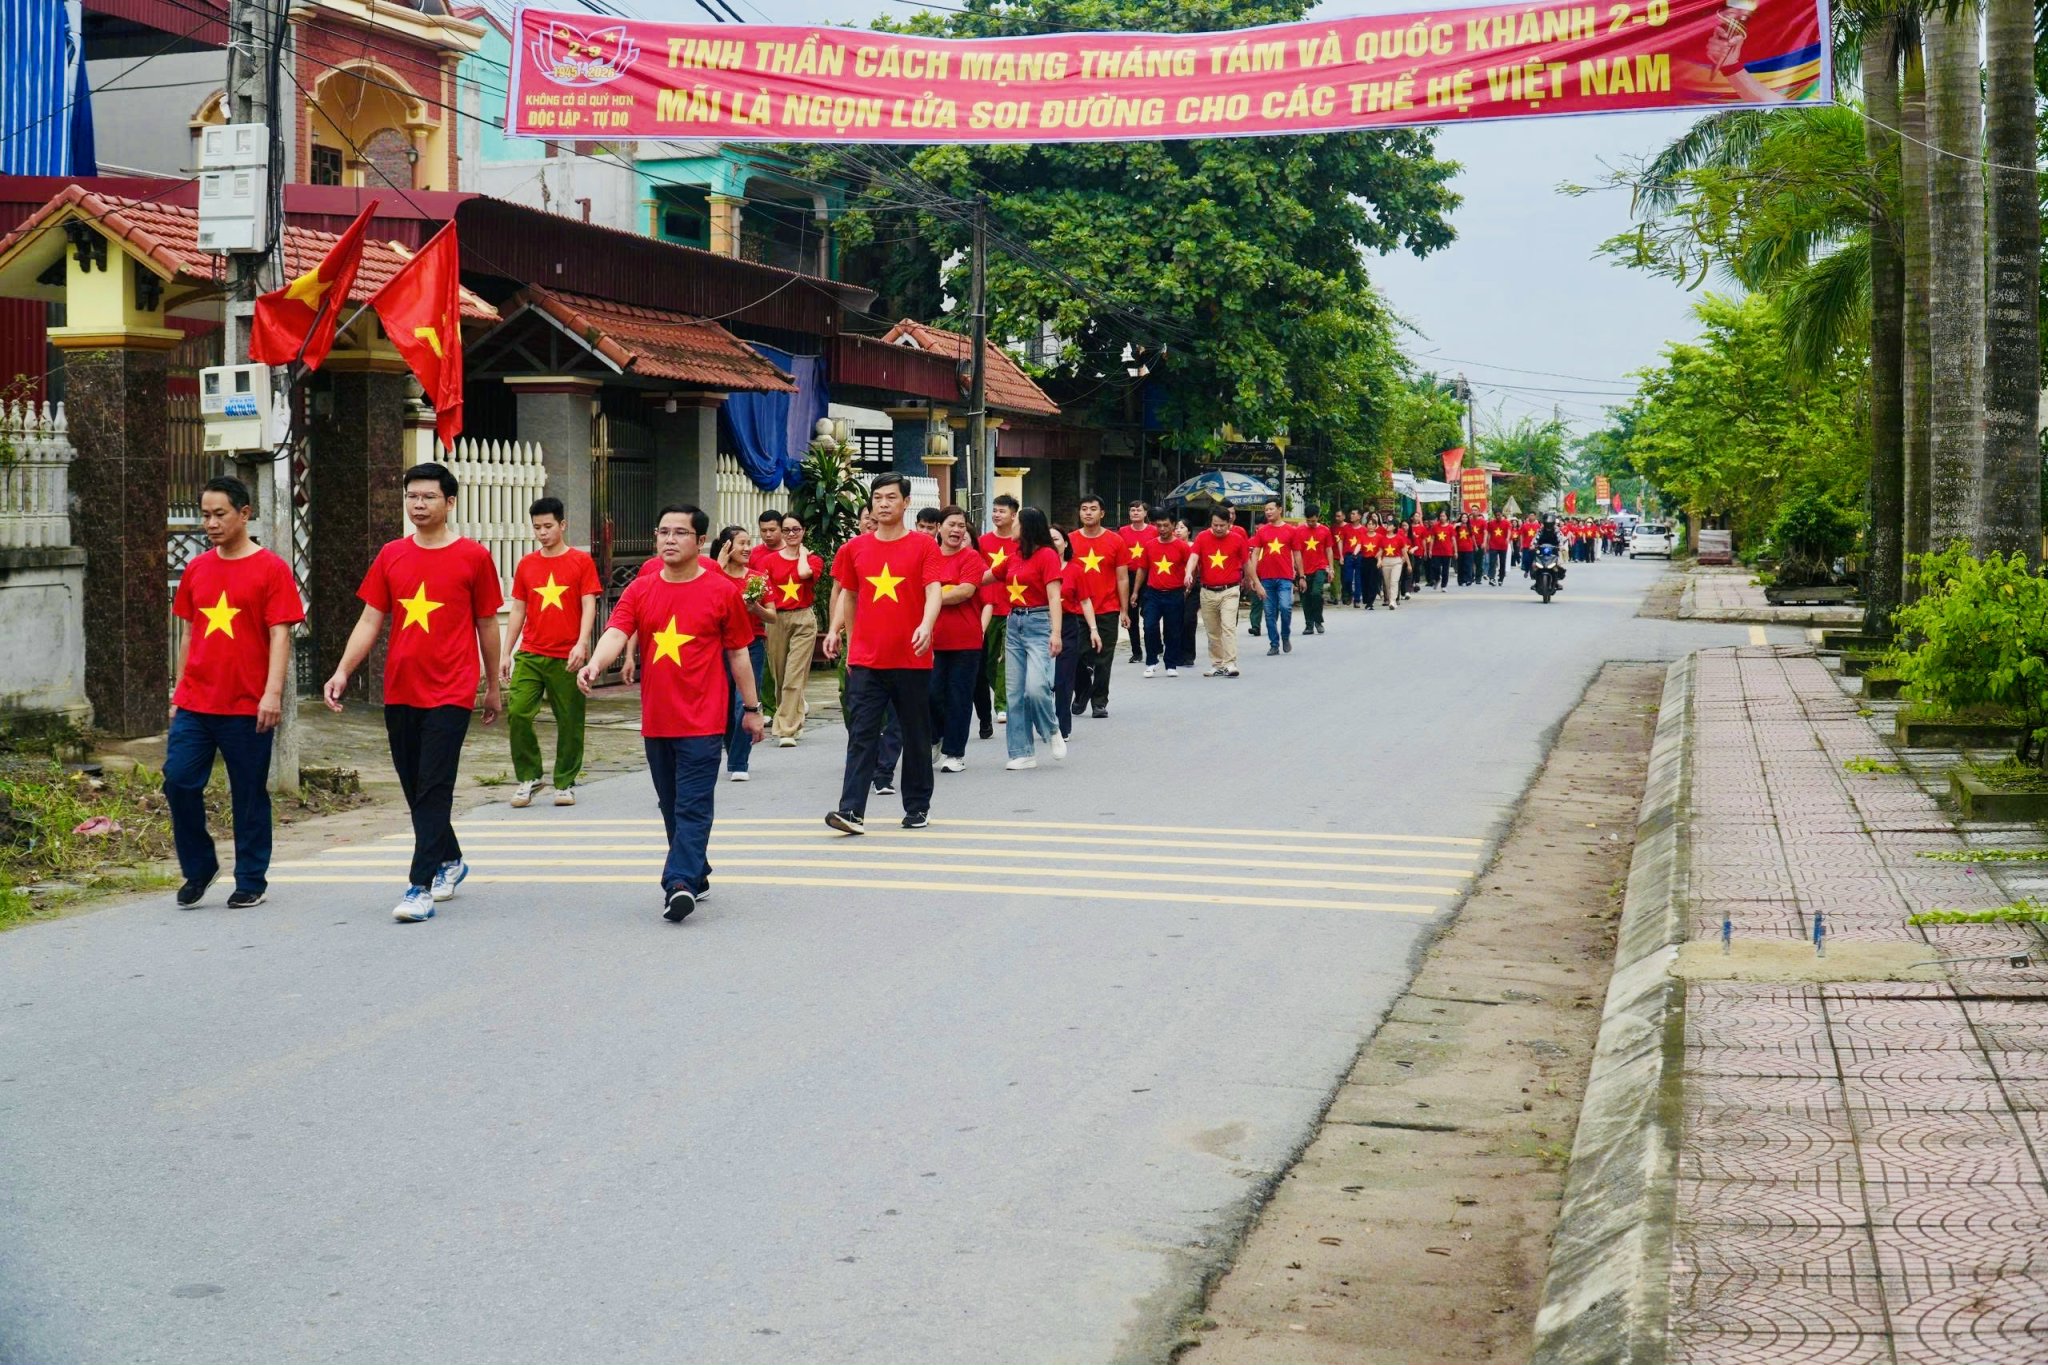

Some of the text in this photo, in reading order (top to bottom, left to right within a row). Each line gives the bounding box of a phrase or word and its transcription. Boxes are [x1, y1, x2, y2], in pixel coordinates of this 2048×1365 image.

[568, 41, 602, 57] 2-9
[667, 37, 745, 70] TINH
[755, 32, 845, 76] THẦN
[854, 43, 951, 80] CÁCH
[959, 51, 1067, 87] MẠNG
[1079, 45, 1197, 78] THÁNG
[1208, 41, 1287, 76] TÁM
[1297, 30, 1343, 68] VÀ
[1355, 17, 1454, 65] QUỐC
[1466, 7, 1596, 52] KHÁNH
[554, 66, 578, 78] 1945
[526, 92, 634, 107] KHÔNG CÓ GÌ QUÝ HƠN
[656, 53, 1672, 134] MÃI LÀ NGỌN LỬA SOI ĐƯỜNG CHO CÁC THẾ HỆ VIỆT NAM
[528, 109, 554, 128] ĐỘC
[558, 109, 581, 129] LẬP
[593, 109, 610, 129] TỰ
[611, 111, 629, 126] DO
